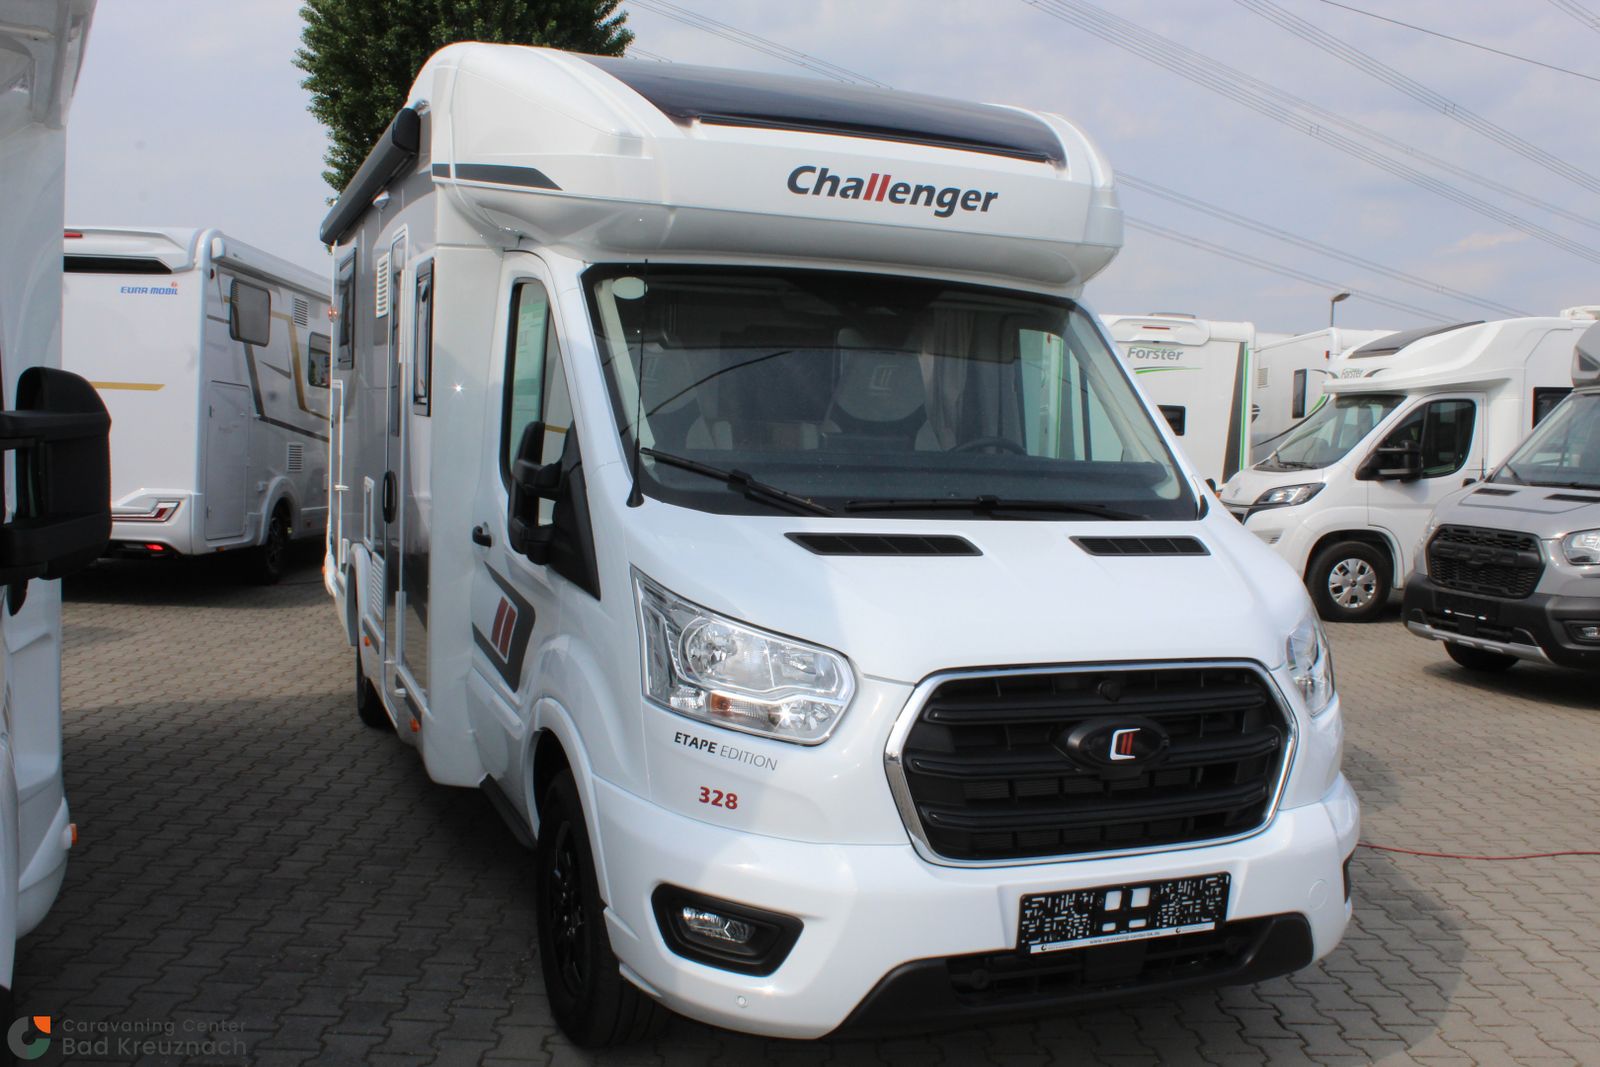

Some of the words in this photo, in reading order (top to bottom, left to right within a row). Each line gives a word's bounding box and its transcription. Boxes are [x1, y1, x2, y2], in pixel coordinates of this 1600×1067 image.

[787, 165, 999, 218] Challenger
[120, 286, 148, 295] EURA
[150, 287, 178, 296] MOBIL
[1127, 347, 1184, 360] Forster
[674, 731, 718, 754] ETAPE
[719, 745, 778, 771] EDITION
[698, 786, 738, 810] 328
